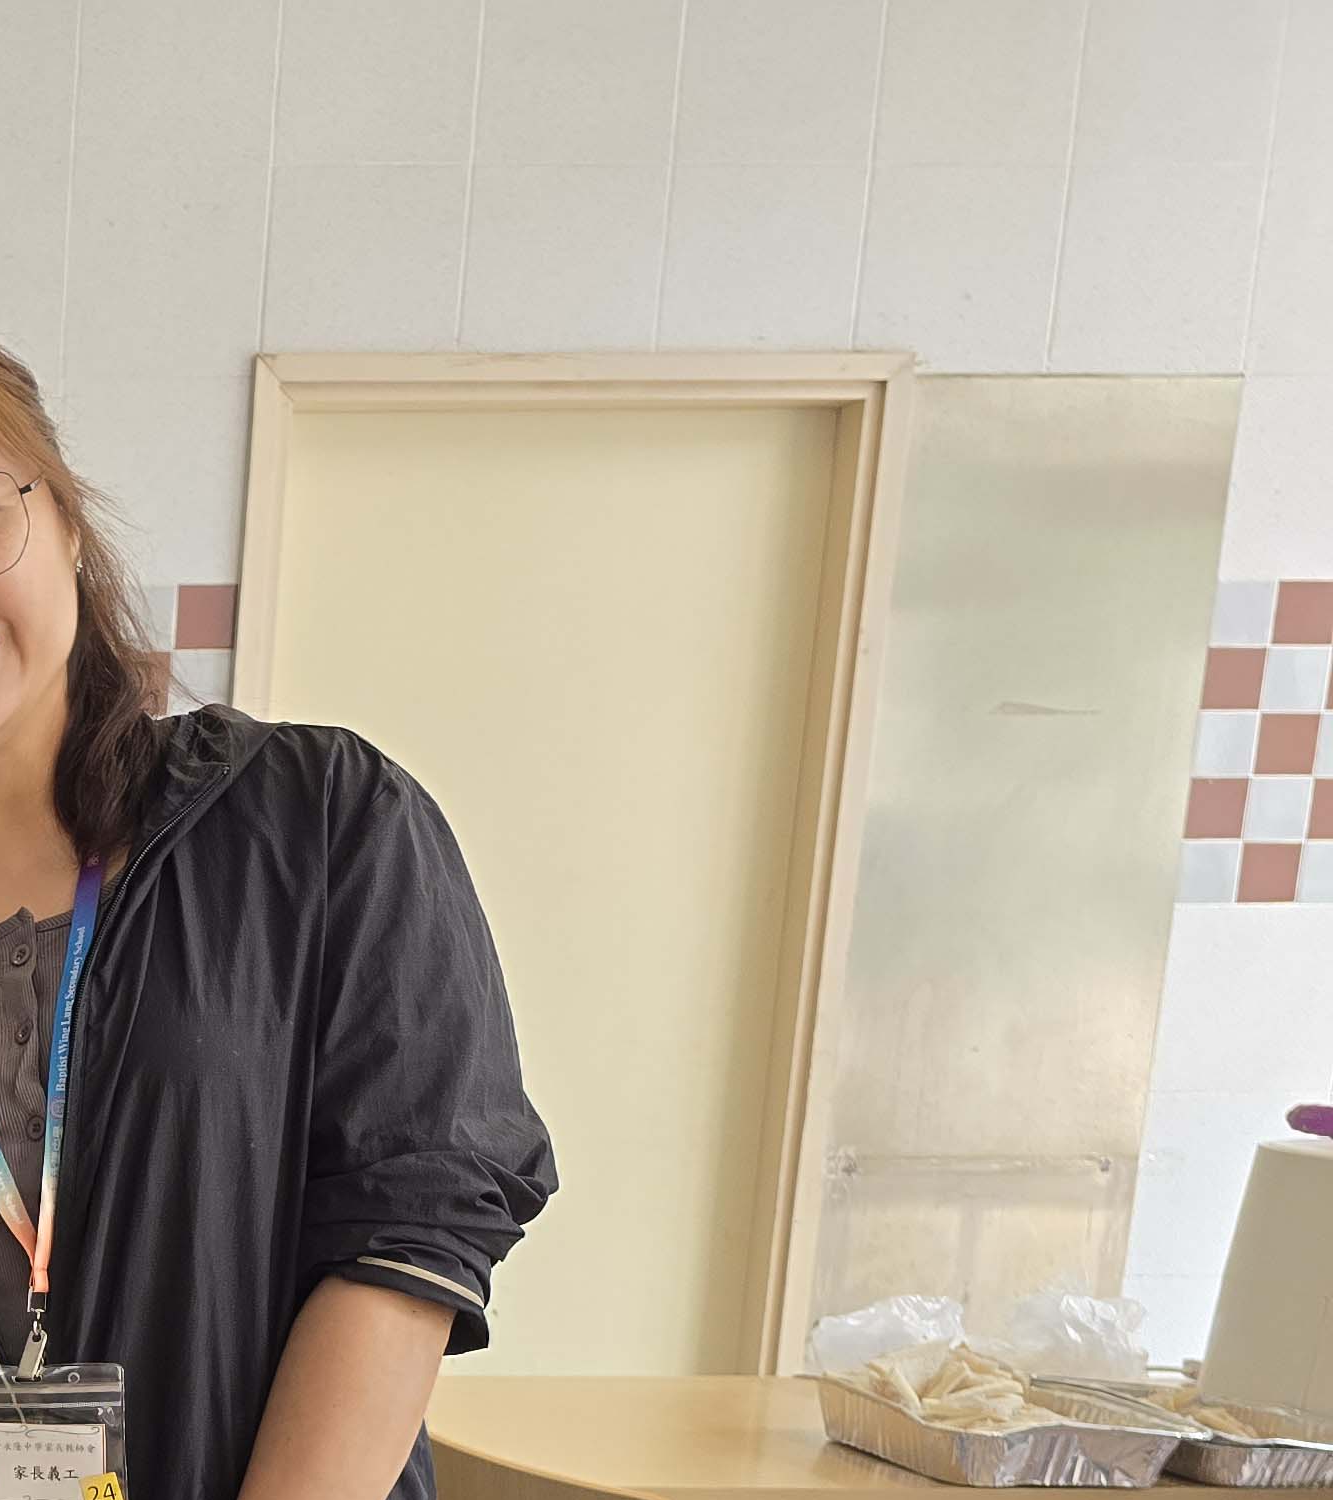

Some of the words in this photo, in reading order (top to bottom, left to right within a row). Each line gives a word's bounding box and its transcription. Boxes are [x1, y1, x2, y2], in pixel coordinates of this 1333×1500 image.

[73, 925, 85, 955] School
[65, 955, 82, 999] Secondary
[61, 999, 74, 1025] Lung
[57, 1026, 70, 1053] Wing
[55, 1054, 68, 1091] Baptist
[13, 1465, 80, 1482] 家長義工
